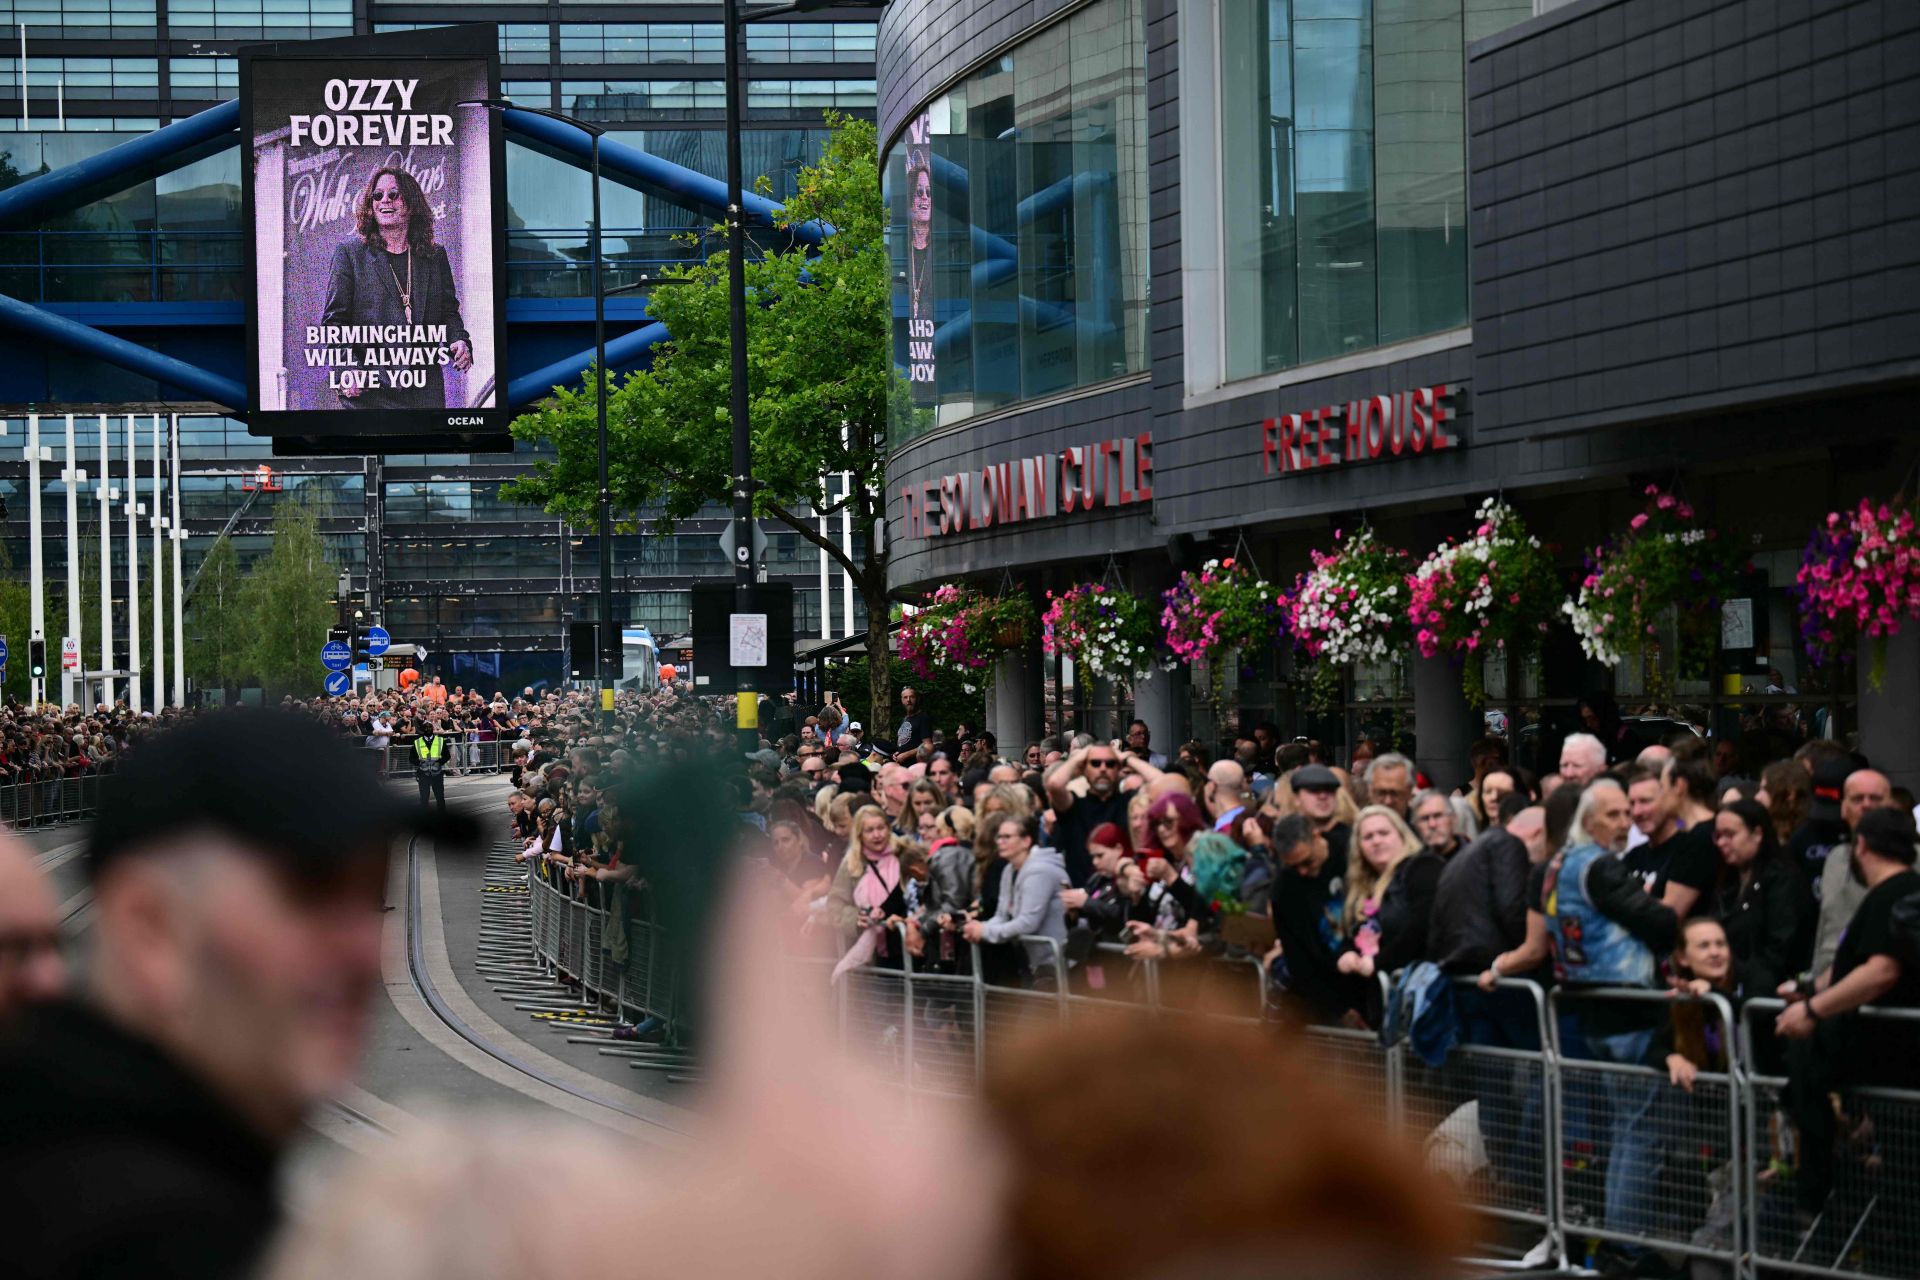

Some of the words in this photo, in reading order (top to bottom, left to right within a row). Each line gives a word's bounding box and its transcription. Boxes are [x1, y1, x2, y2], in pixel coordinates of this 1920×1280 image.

[324, 78, 419, 111] OZZY
[289, 114, 455, 147] FOREVER
[306, 324, 448, 345] BIRMINGHAM
[304, 348, 357, 367] WILL
[364, 346, 450, 366] ALWAYS
[329, 370, 381, 389] LOVE
[386, 369, 427, 388] YOU
[447, 416, 484, 426] OCEAN
[1264, 405, 1338, 476] FREE
[1346, 384, 1454, 461] HOUSE
[902, 479, 938, 541] THE
[940, 454, 1052, 536] SOLOMAN
